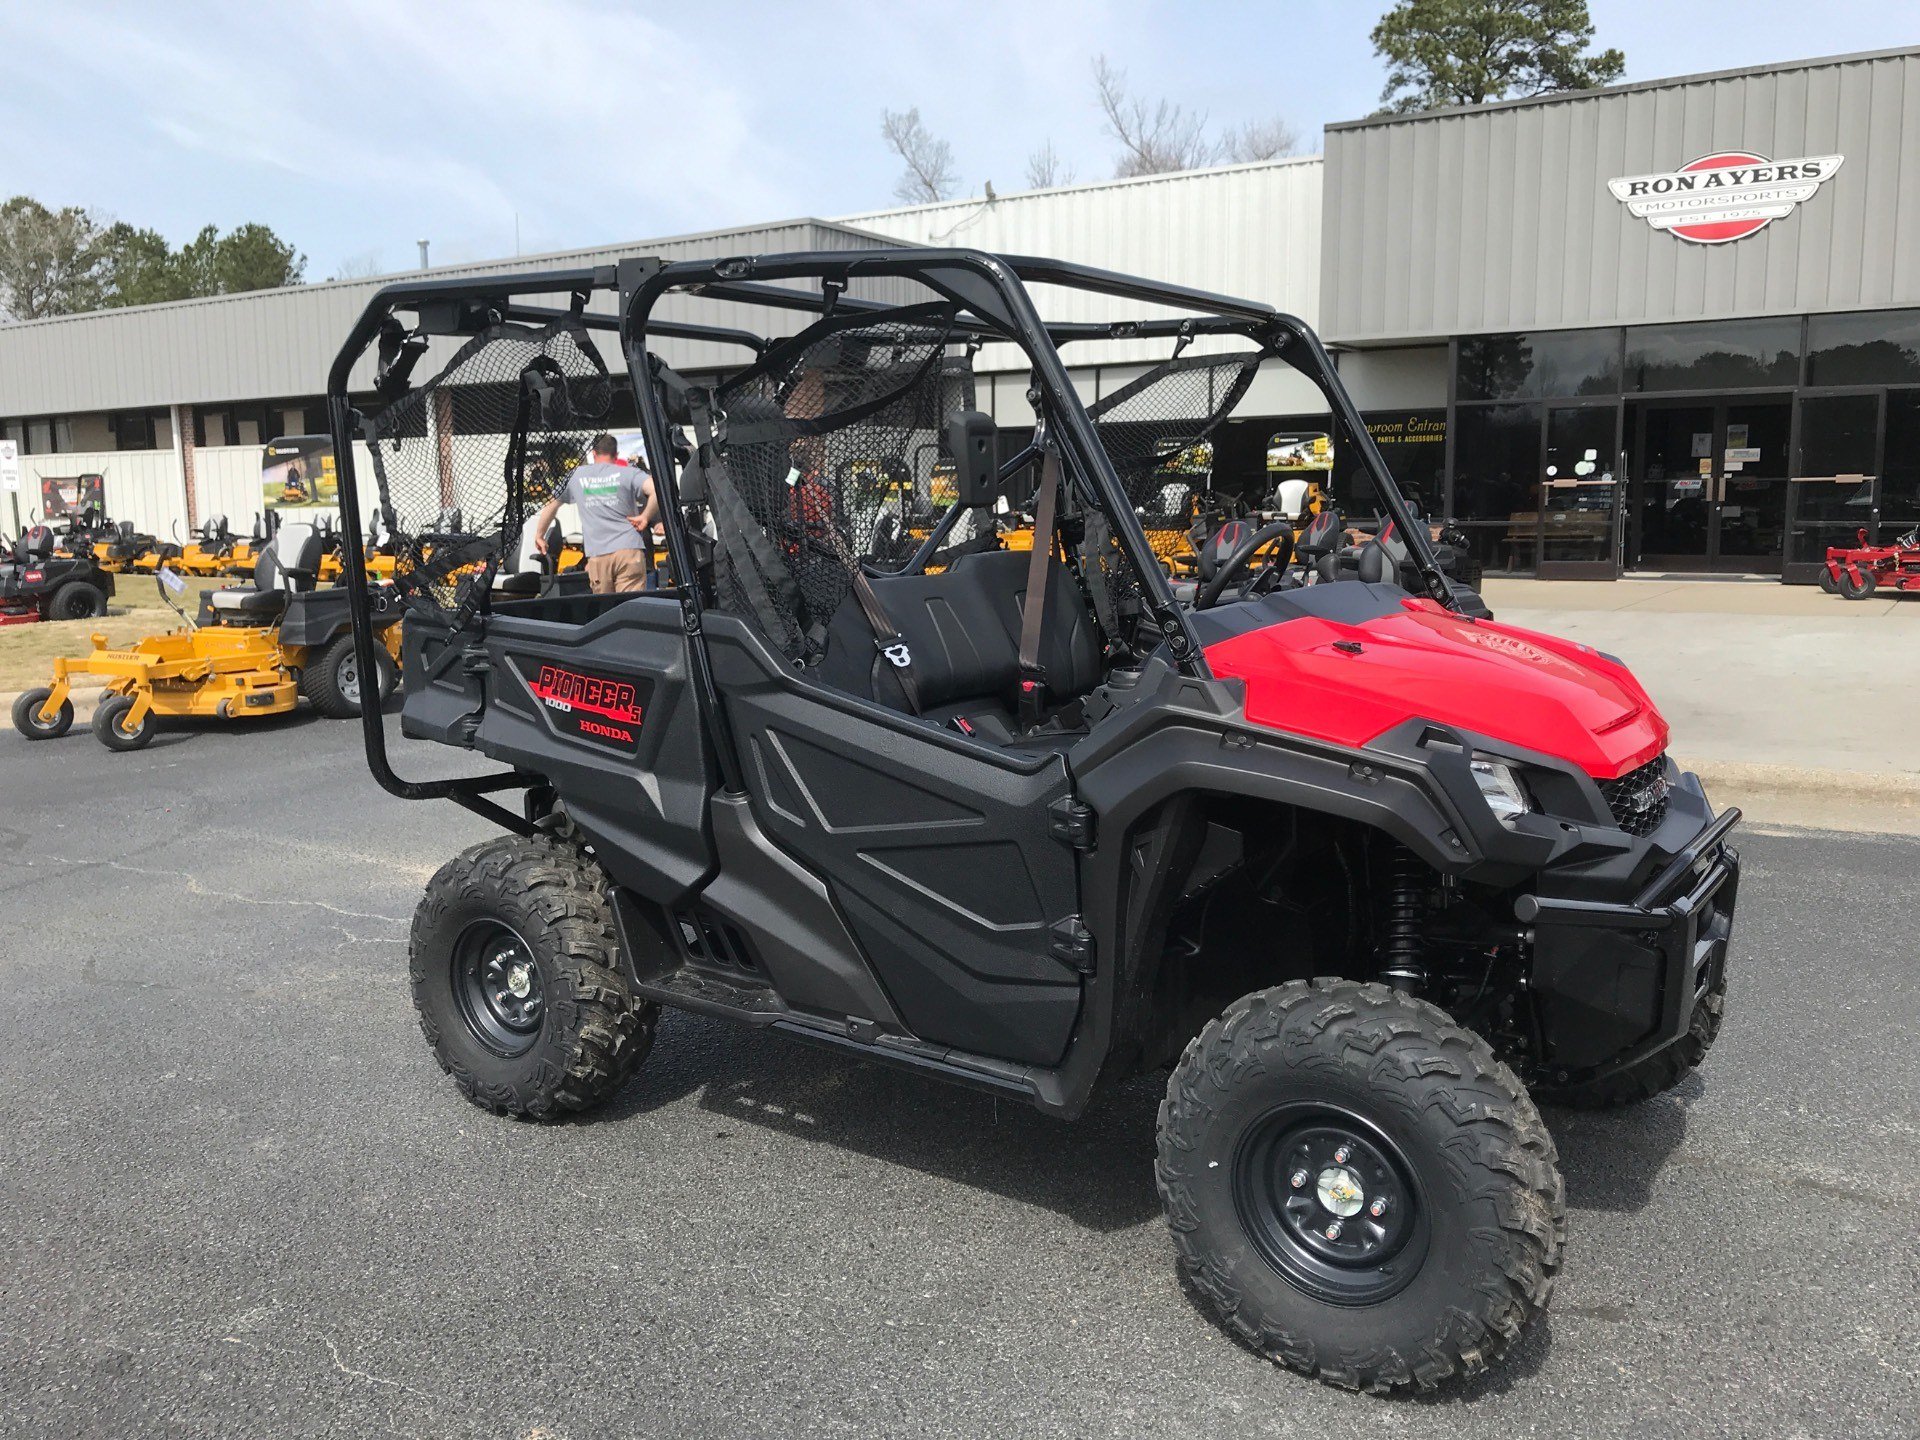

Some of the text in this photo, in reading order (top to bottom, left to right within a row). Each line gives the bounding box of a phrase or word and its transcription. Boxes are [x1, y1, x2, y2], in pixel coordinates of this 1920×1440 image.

[1628, 162, 1822, 197] RON AYERS
[1645, 189, 1798, 211] MOTORSPORTS
[1722, 209, 1761, 220] 1975
[1405, 434, 1443, 443] ACCESSORIES
[539, 665, 635, 712] PIONEER
[545, 696, 571, 713] 1000
[579, 720, 633, 742] HONDA
